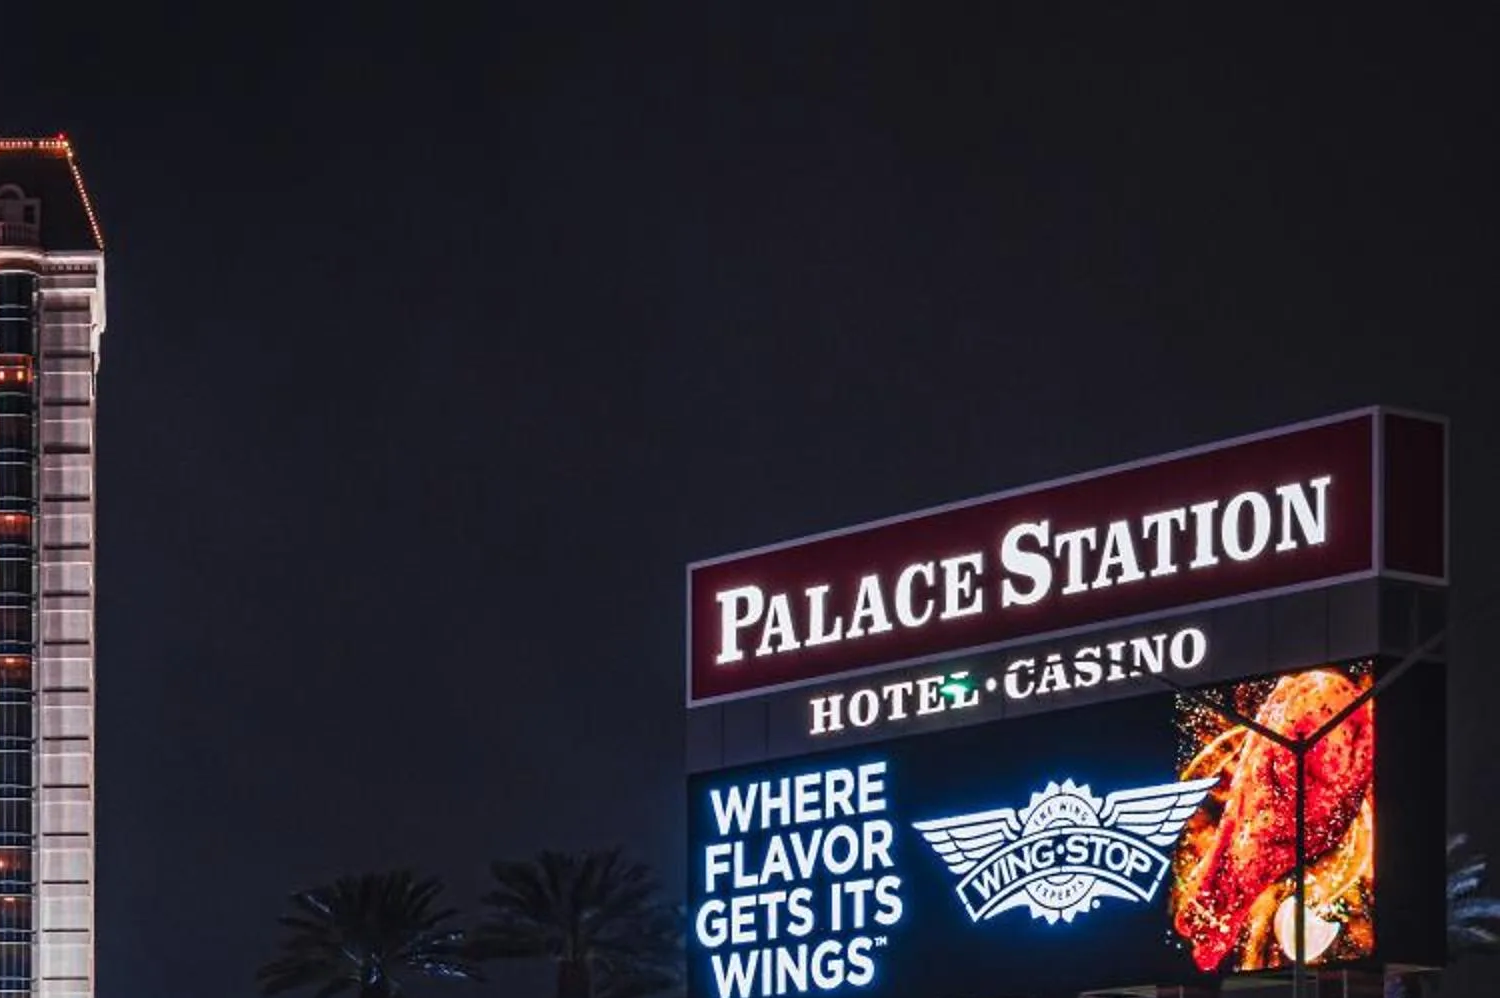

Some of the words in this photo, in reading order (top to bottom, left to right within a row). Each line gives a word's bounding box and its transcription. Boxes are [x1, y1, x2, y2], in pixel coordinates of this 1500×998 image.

[715, 552, 984, 666] PALACE
[1000, 475, 1332, 609] STATION
[809, 670, 980, 736] HOTEL
[1003, 627, 1208, 699] CASINO
[709, 761, 887, 836] WHERE
[705, 819, 895, 893] FLAVOR
[695, 887, 816, 948] GETS
[831, 875, 903, 931] ITS
